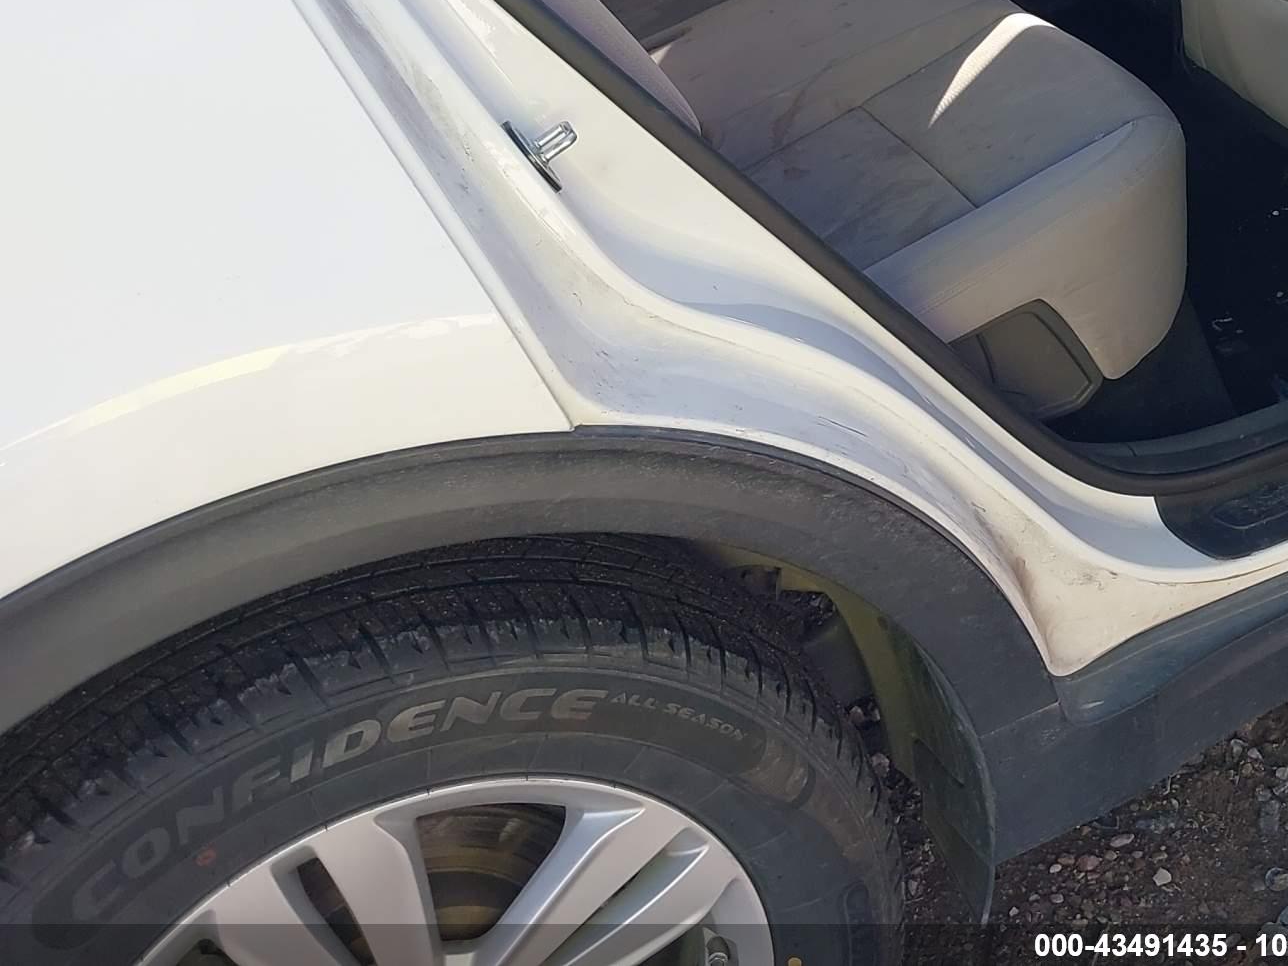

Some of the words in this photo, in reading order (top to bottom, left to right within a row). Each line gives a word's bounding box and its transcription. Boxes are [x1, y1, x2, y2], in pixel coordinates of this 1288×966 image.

[72, 687, 608, 922] CONFIDENCE
[610, 691, 658, 711] ALL
[661, 701, 748, 742] SEASON
